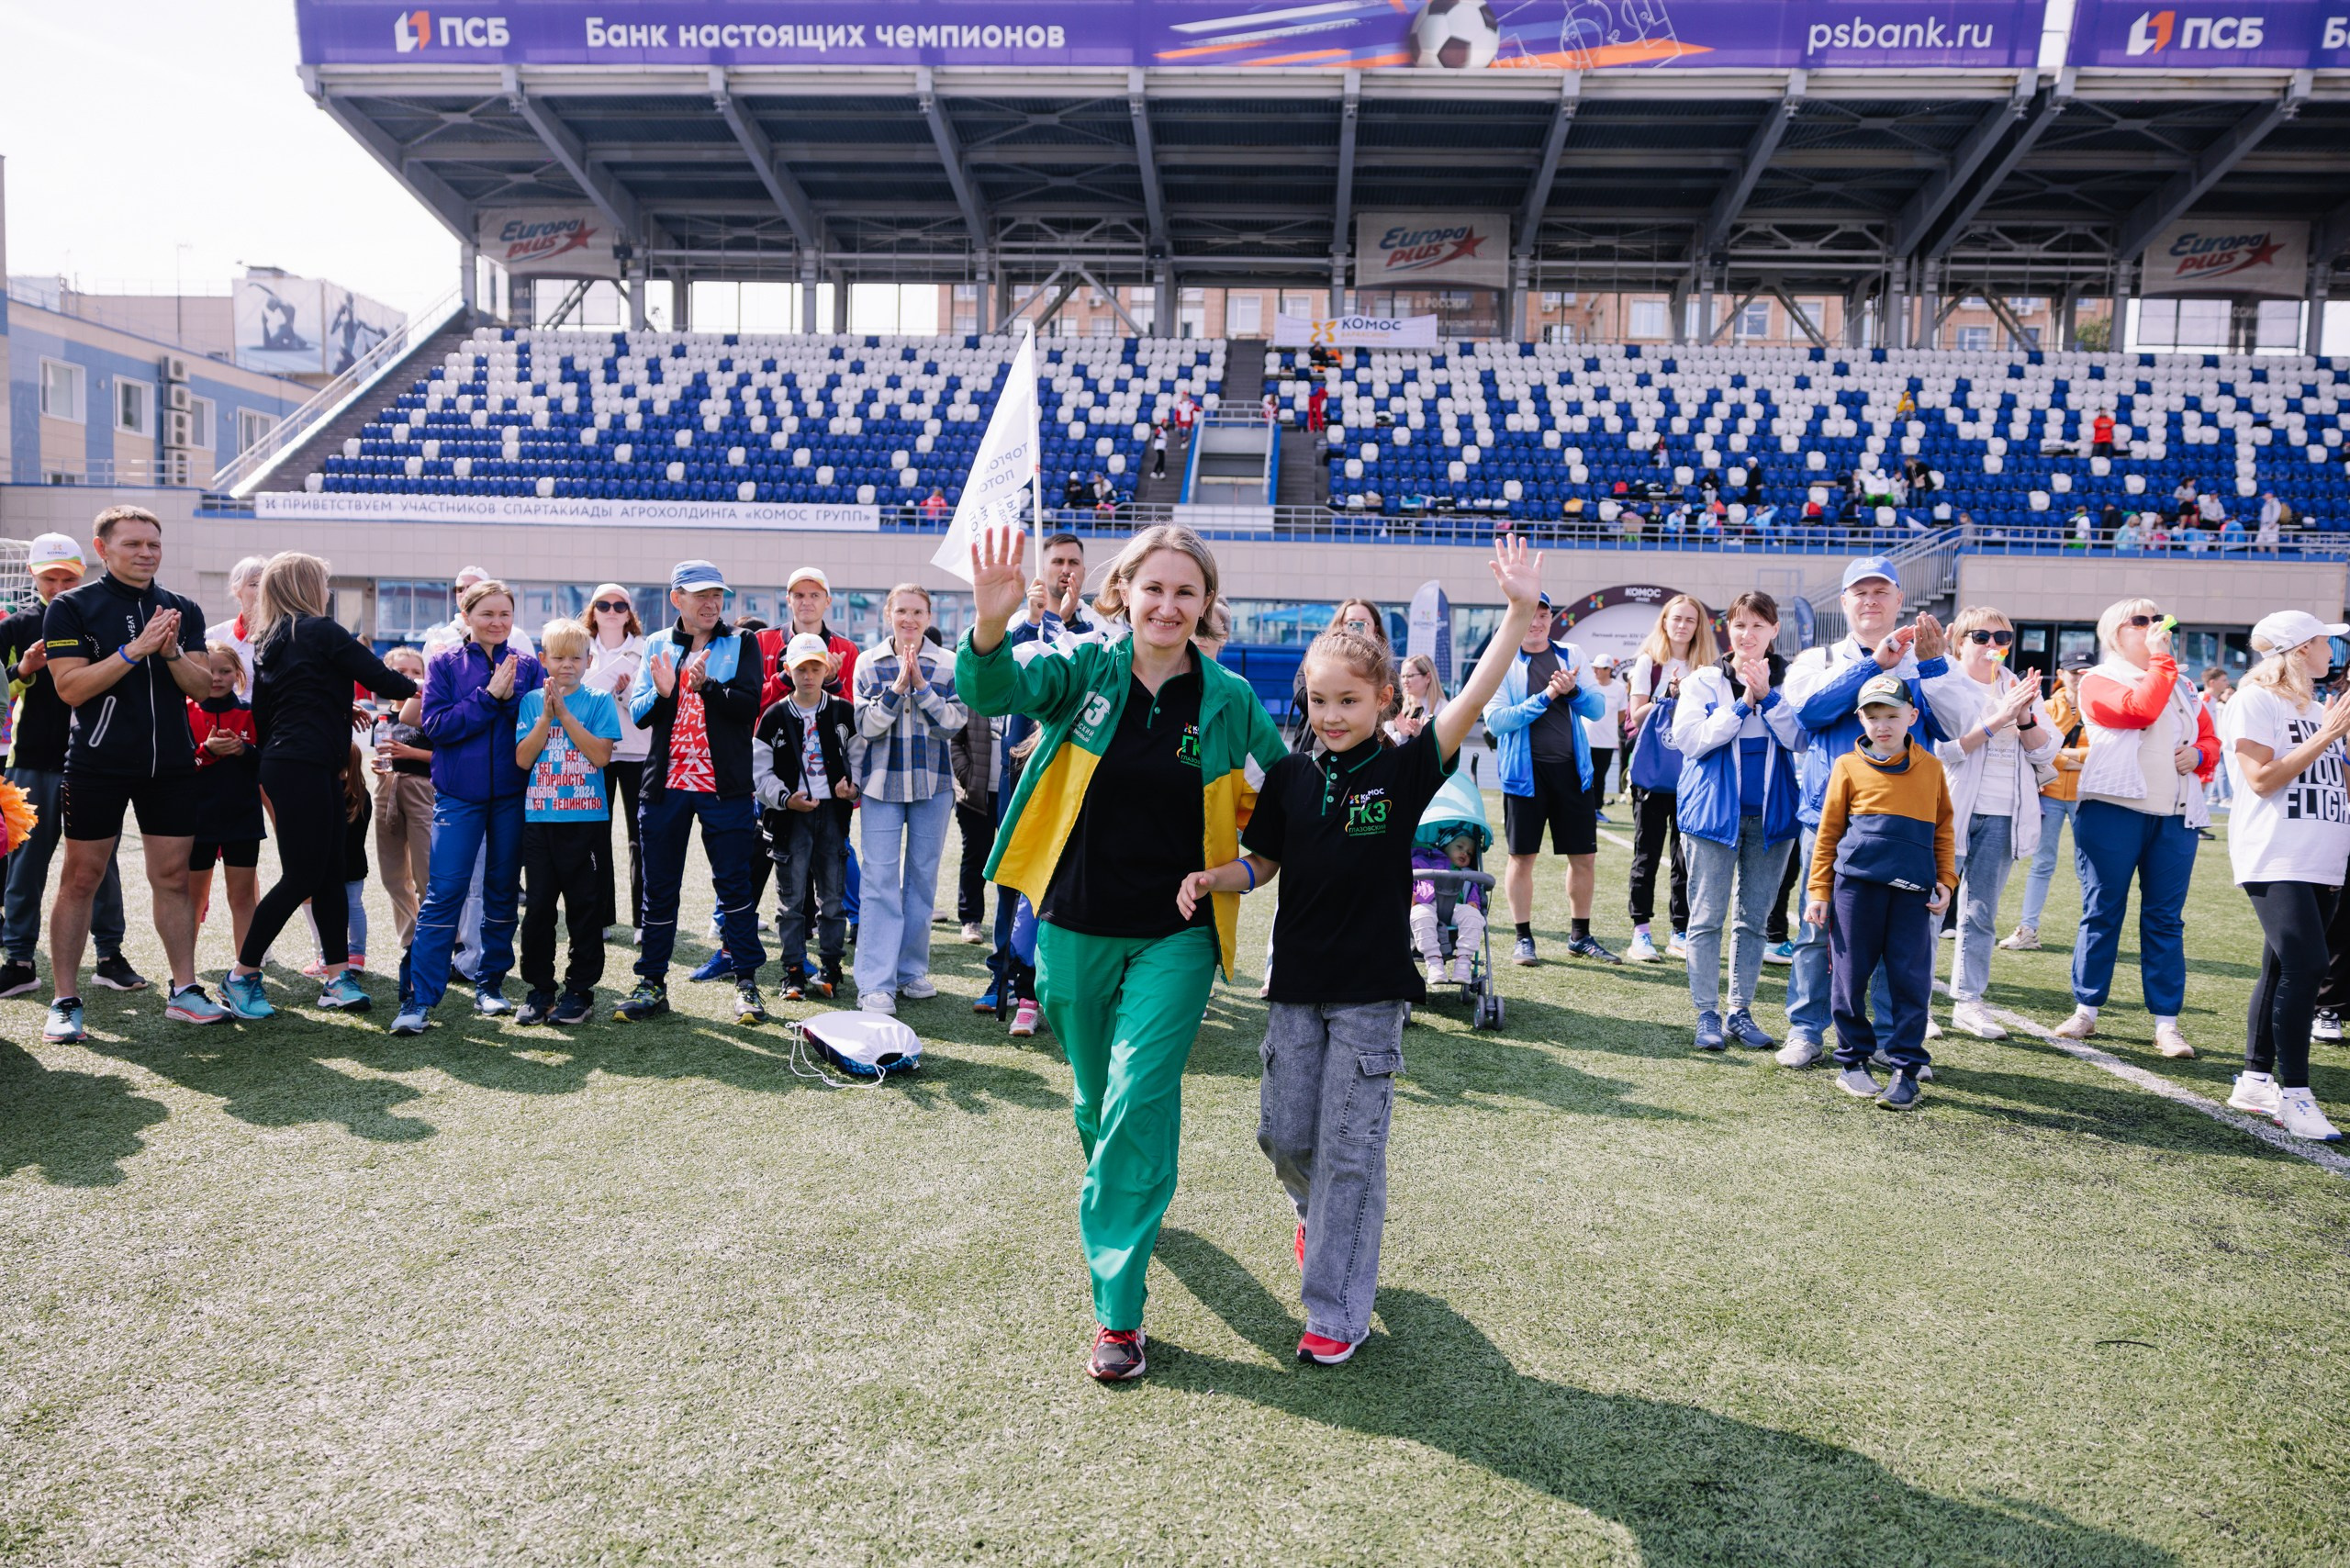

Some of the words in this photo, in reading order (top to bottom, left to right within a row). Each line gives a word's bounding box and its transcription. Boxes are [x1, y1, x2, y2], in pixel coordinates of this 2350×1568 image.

[439, 17, 510, 48] ПСБ
[585, 17, 668, 48] Банк
[678, 24, 867, 52] настоящих
[875, 24, 1067, 49] чемпионов
[1807, 16, 1994, 56] psbank.ru
[2180, 17, 2265, 50] ПСБ
[2322, 17, 2350, 50] Б
[1341, 318, 1402, 330] КОМОС
[282, 498, 392, 511] ПРИВЕТСТВУЕМ
[400, 500, 496, 515] УЧАСТНИКОВ
[504, 502, 613, 518] СПАРТАКИАДЫ
[620, 506, 738, 521] АГРОХОЛДИНГА
[744, 508, 809, 521] «КОМОС
[815, 510, 871, 522] ГРУПП»
[1625, 587, 1662, 599] КОМОС
[536, 774, 586, 786] #ГОРДОСТЬ
[2304, 755, 2346, 788] YOU
[552, 798, 602, 811] #ЕДИНСТВО
[573, 786, 596, 798] 2024
[2283, 788, 2350, 823] FLIGH
[1349, 801, 1386, 826] ГКЗ
